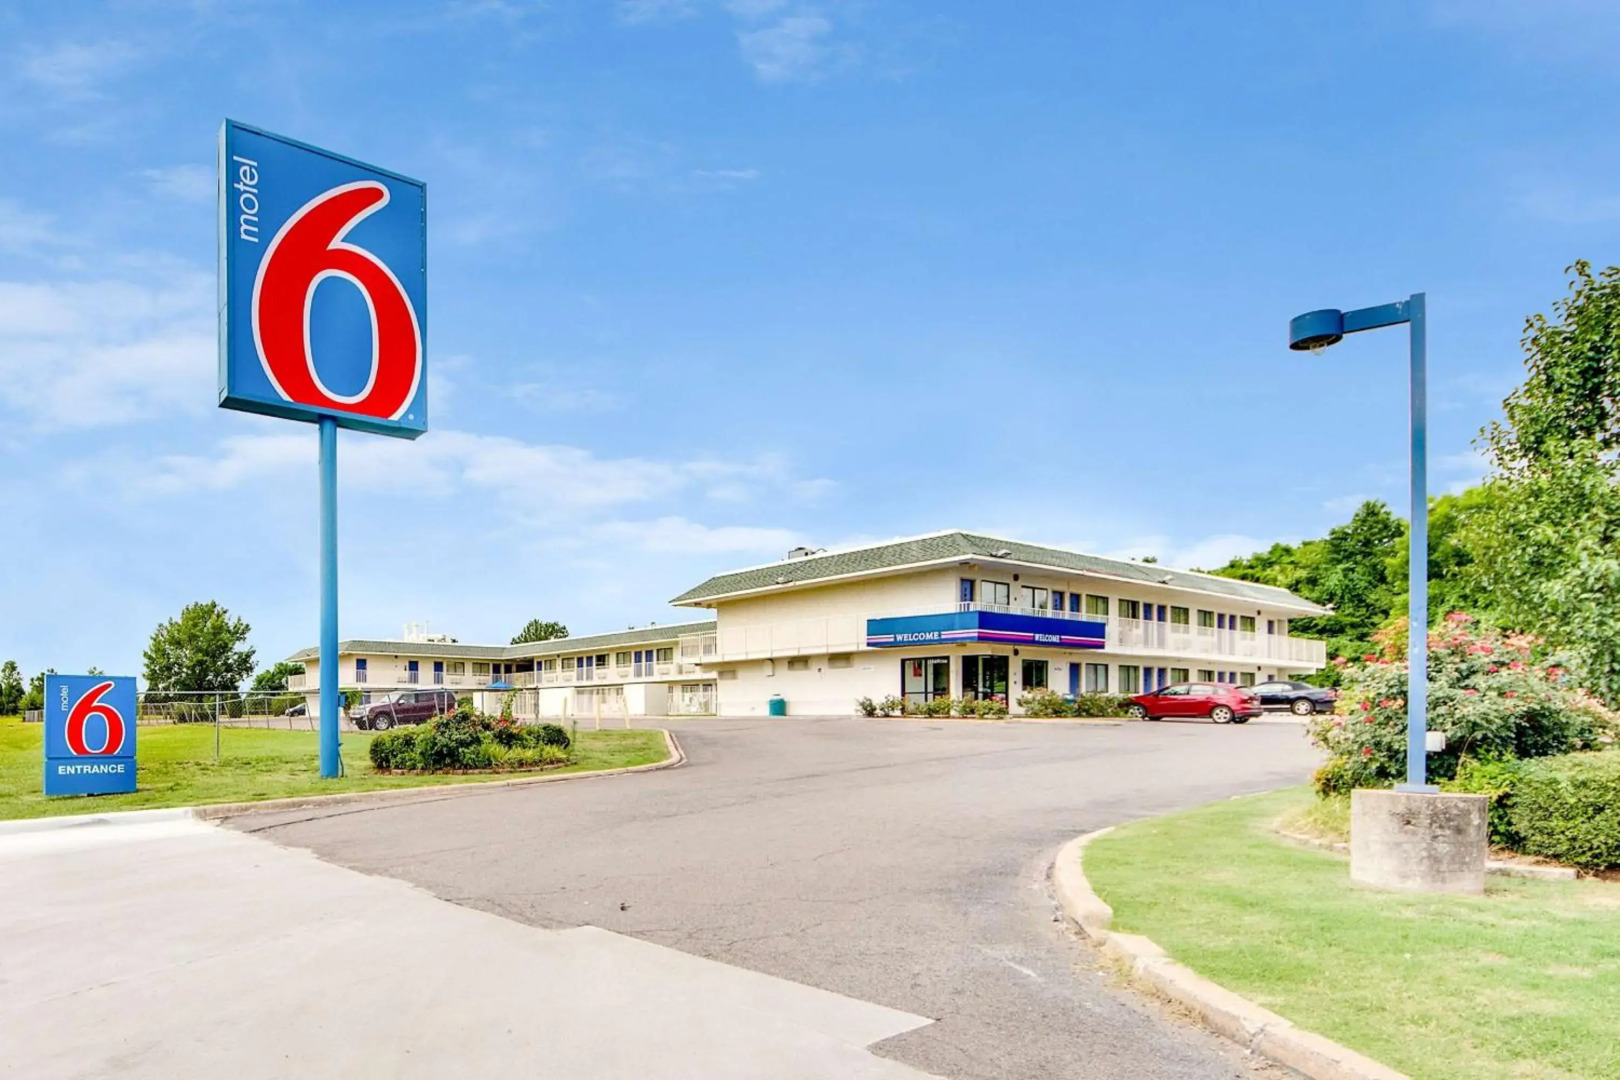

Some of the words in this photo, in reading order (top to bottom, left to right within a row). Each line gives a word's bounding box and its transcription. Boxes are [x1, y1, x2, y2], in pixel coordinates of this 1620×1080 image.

[233, 155, 259, 243] motel
[251, 180, 423, 421] 6
[895, 631, 940, 642] WELCOME
[1034, 633, 1060, 643] WELCOME
[60, 685, 69, 711] motel
[65, 681, 125, 755] 6
[58, 764, 125, 775] ENTRANCE
